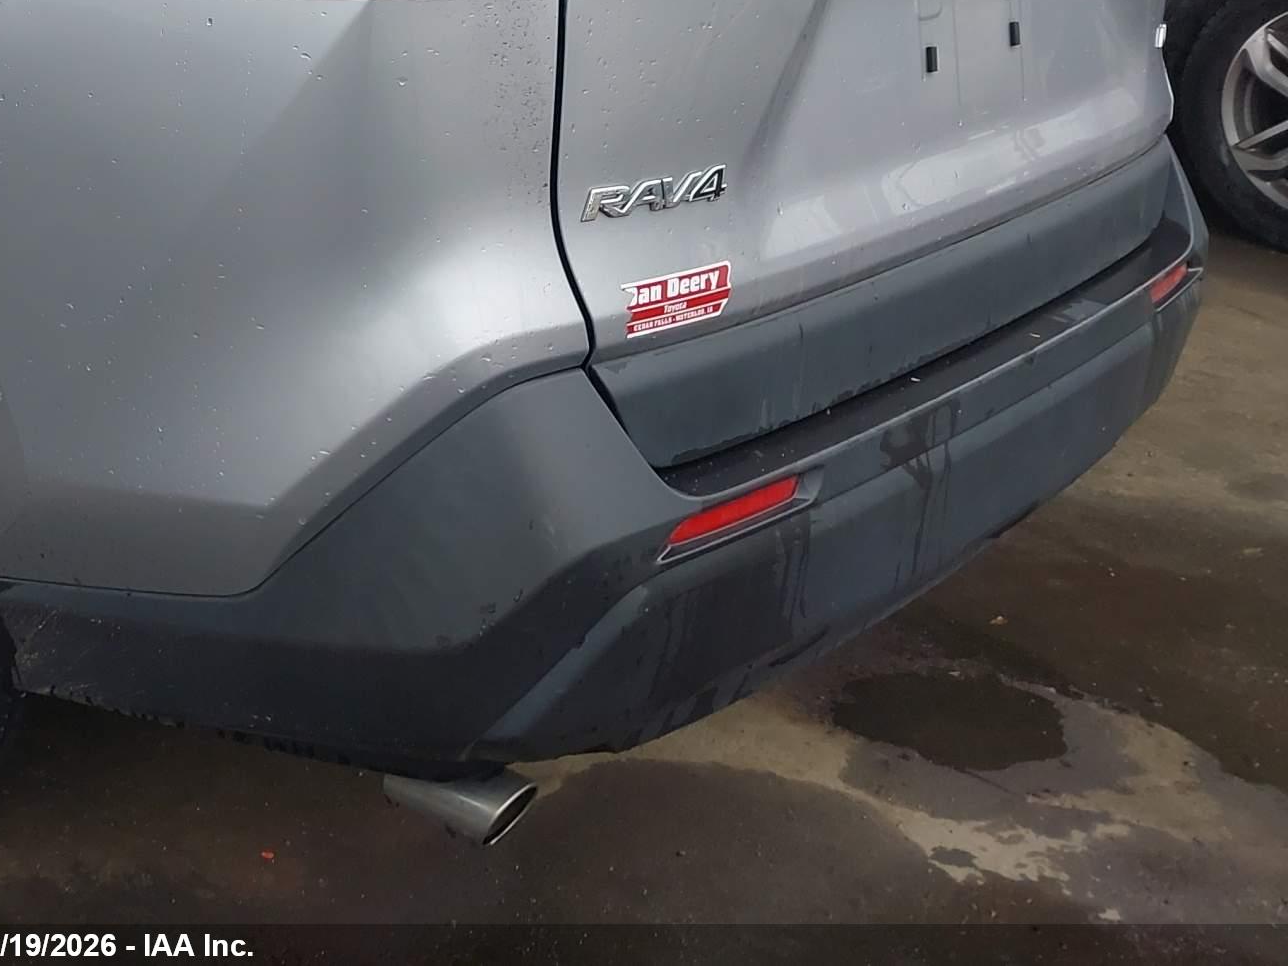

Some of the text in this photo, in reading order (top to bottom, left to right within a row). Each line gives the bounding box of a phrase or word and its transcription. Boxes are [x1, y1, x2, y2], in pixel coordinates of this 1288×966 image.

[580, 164, 728, 222] RAV4
[666, 270, 720, 298] Deery
[663, 301, 688, 314] Toyota
